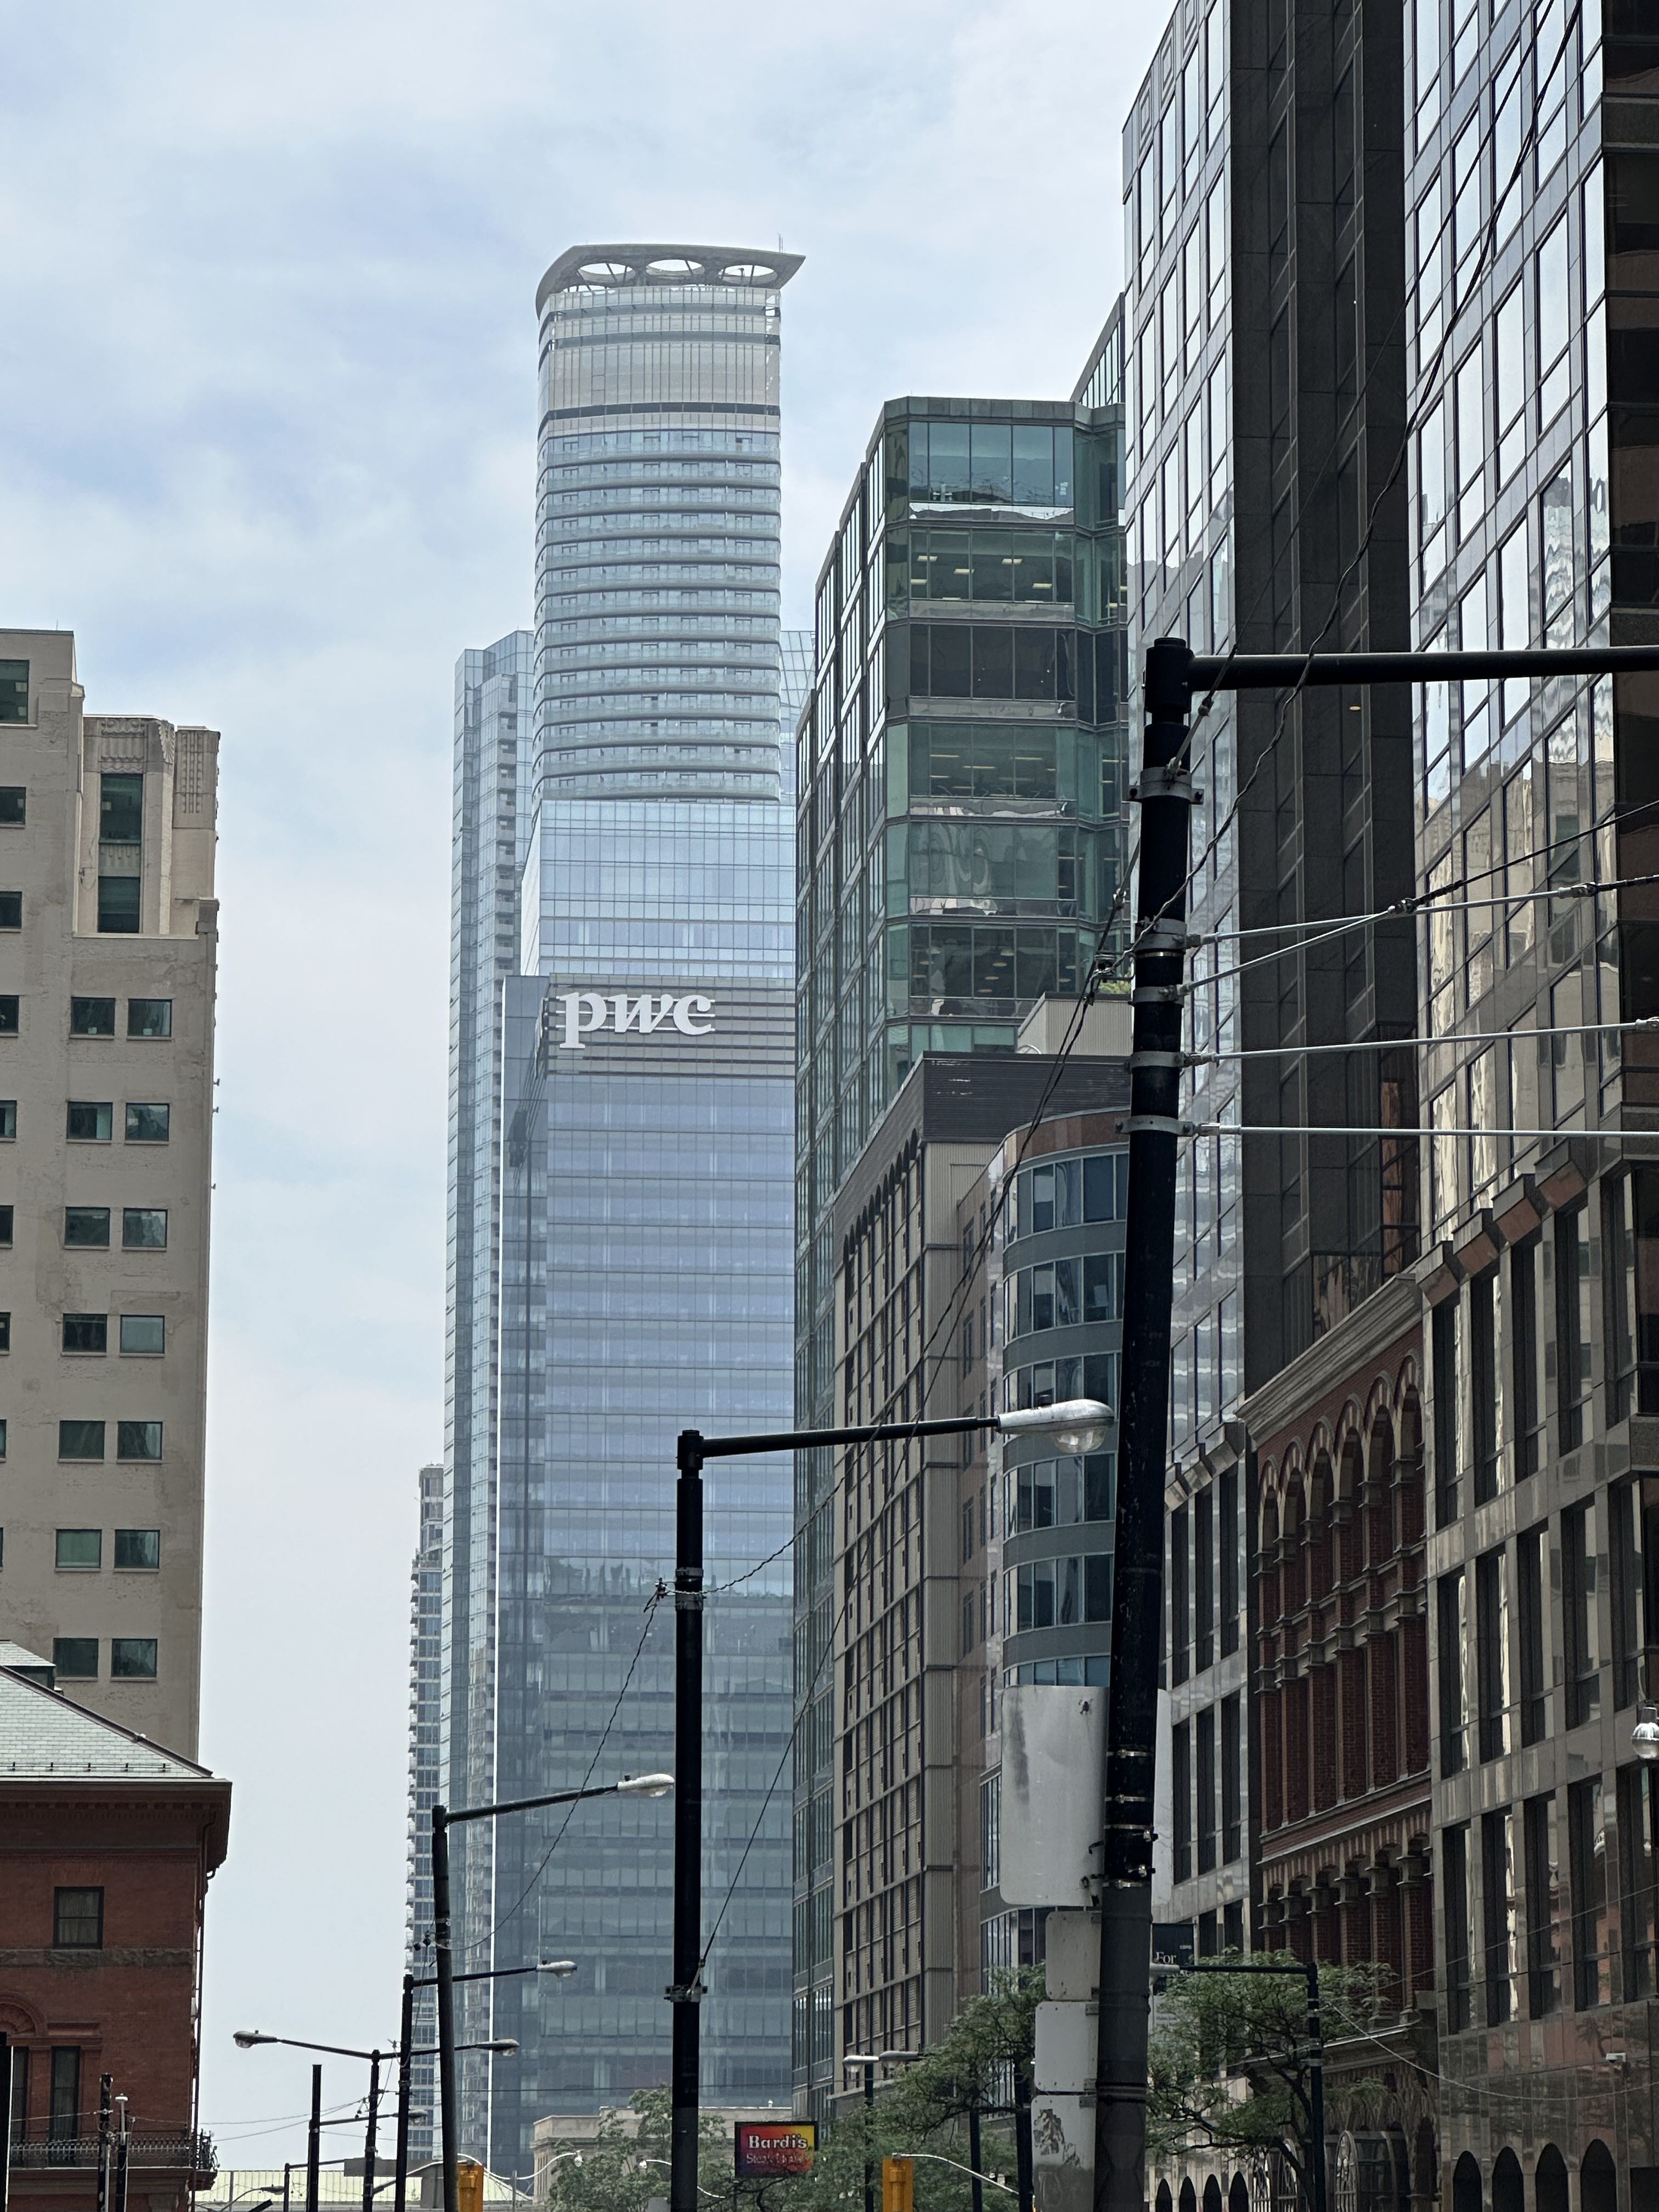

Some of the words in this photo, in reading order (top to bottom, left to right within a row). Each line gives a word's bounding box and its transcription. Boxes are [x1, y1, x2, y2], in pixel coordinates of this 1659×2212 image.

[557, 992, 712, 1048] pwc
[1156, 1951, 1176, 1964] For
[748, 2134, 808, 2149] Bardi's
